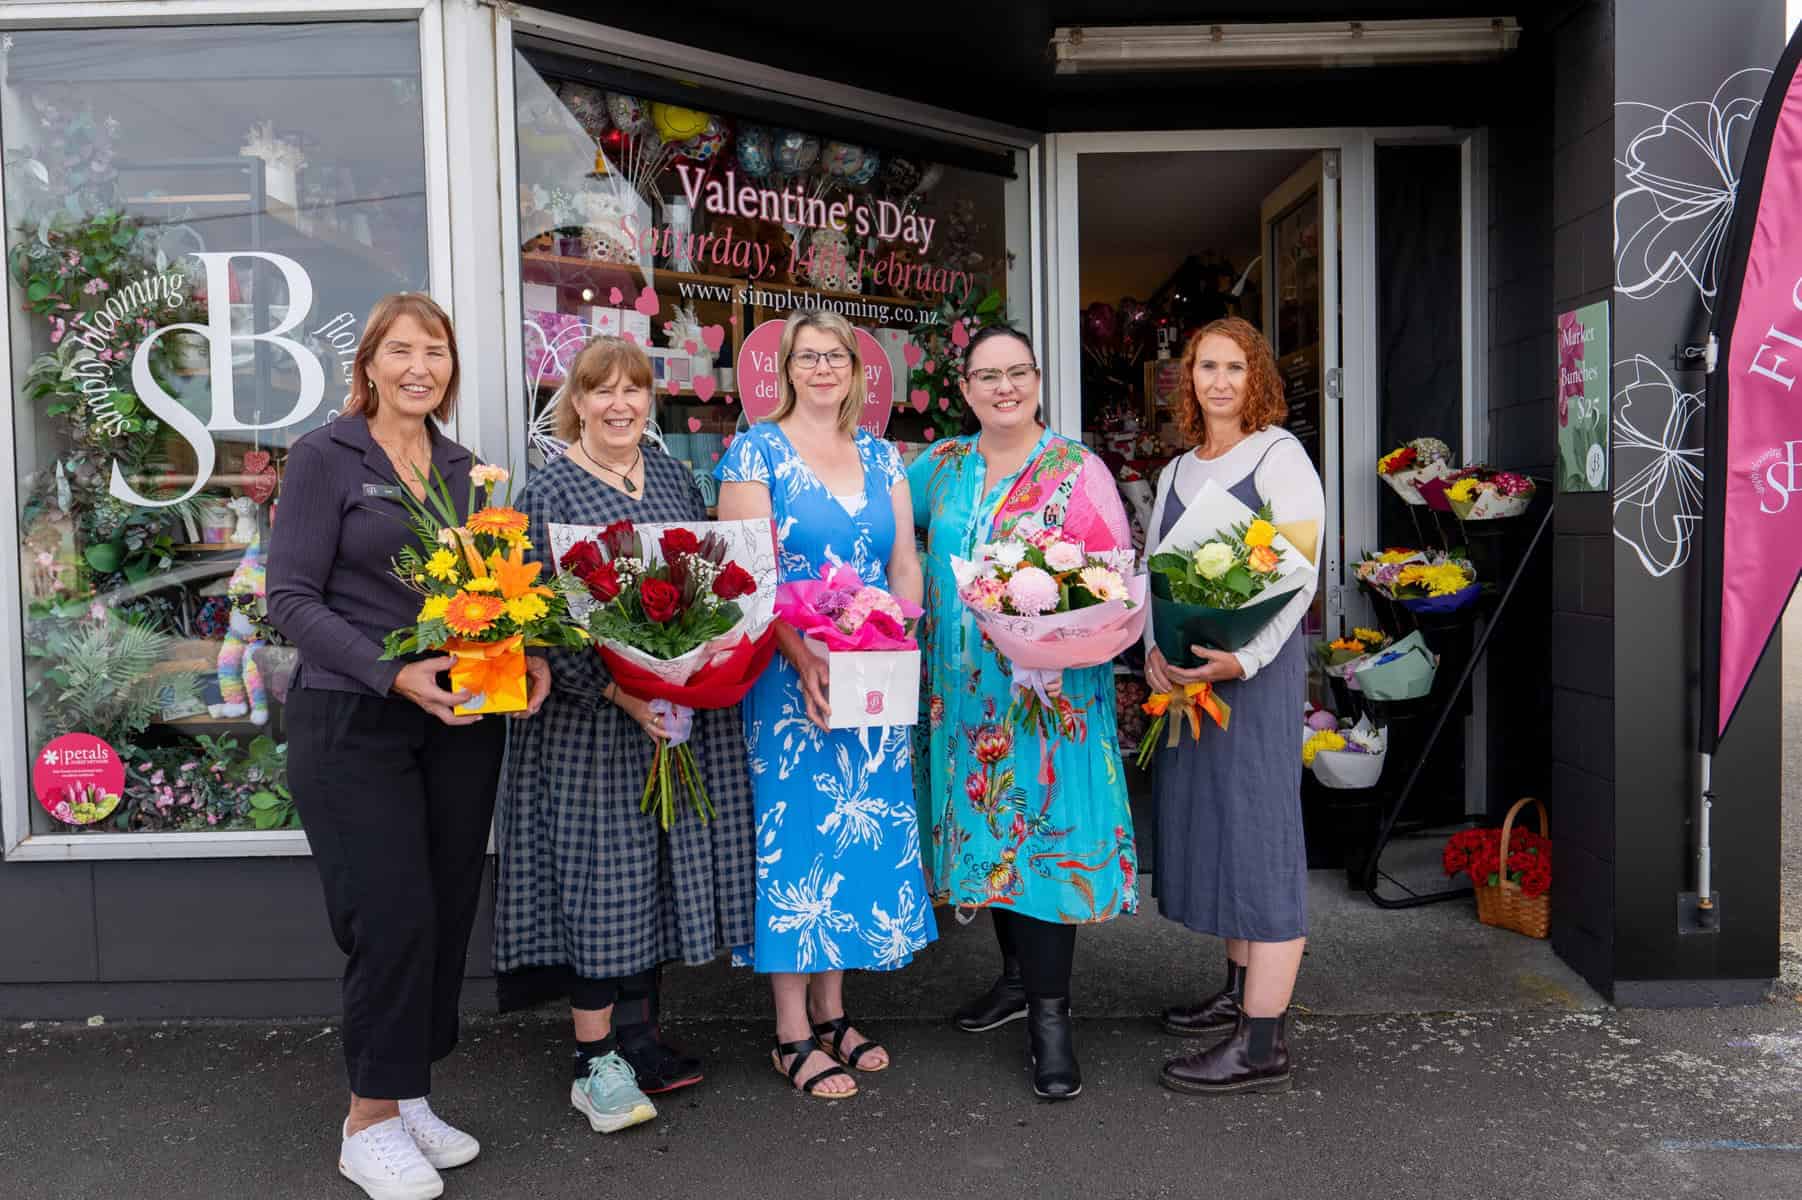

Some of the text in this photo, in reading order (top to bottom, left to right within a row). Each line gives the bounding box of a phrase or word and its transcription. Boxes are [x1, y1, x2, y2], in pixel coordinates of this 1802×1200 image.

[675, 164, 936, 255] Valentine's Day
[620, 214, 975, 304] Saturday, 14th February
[73, 269, 185, 352] blooming
[678, 281, 940, 325] www.simplyblooming.co.nz
[1562, 326, 1596, 346] Market
[864, 363, 882, 386] ay
[1561, 365, 1598, 386] Bunches
[71, 356, 131, 438] simply
[1576, 396, 1601, 432] $25
[64, 744, 110, 766] petals
